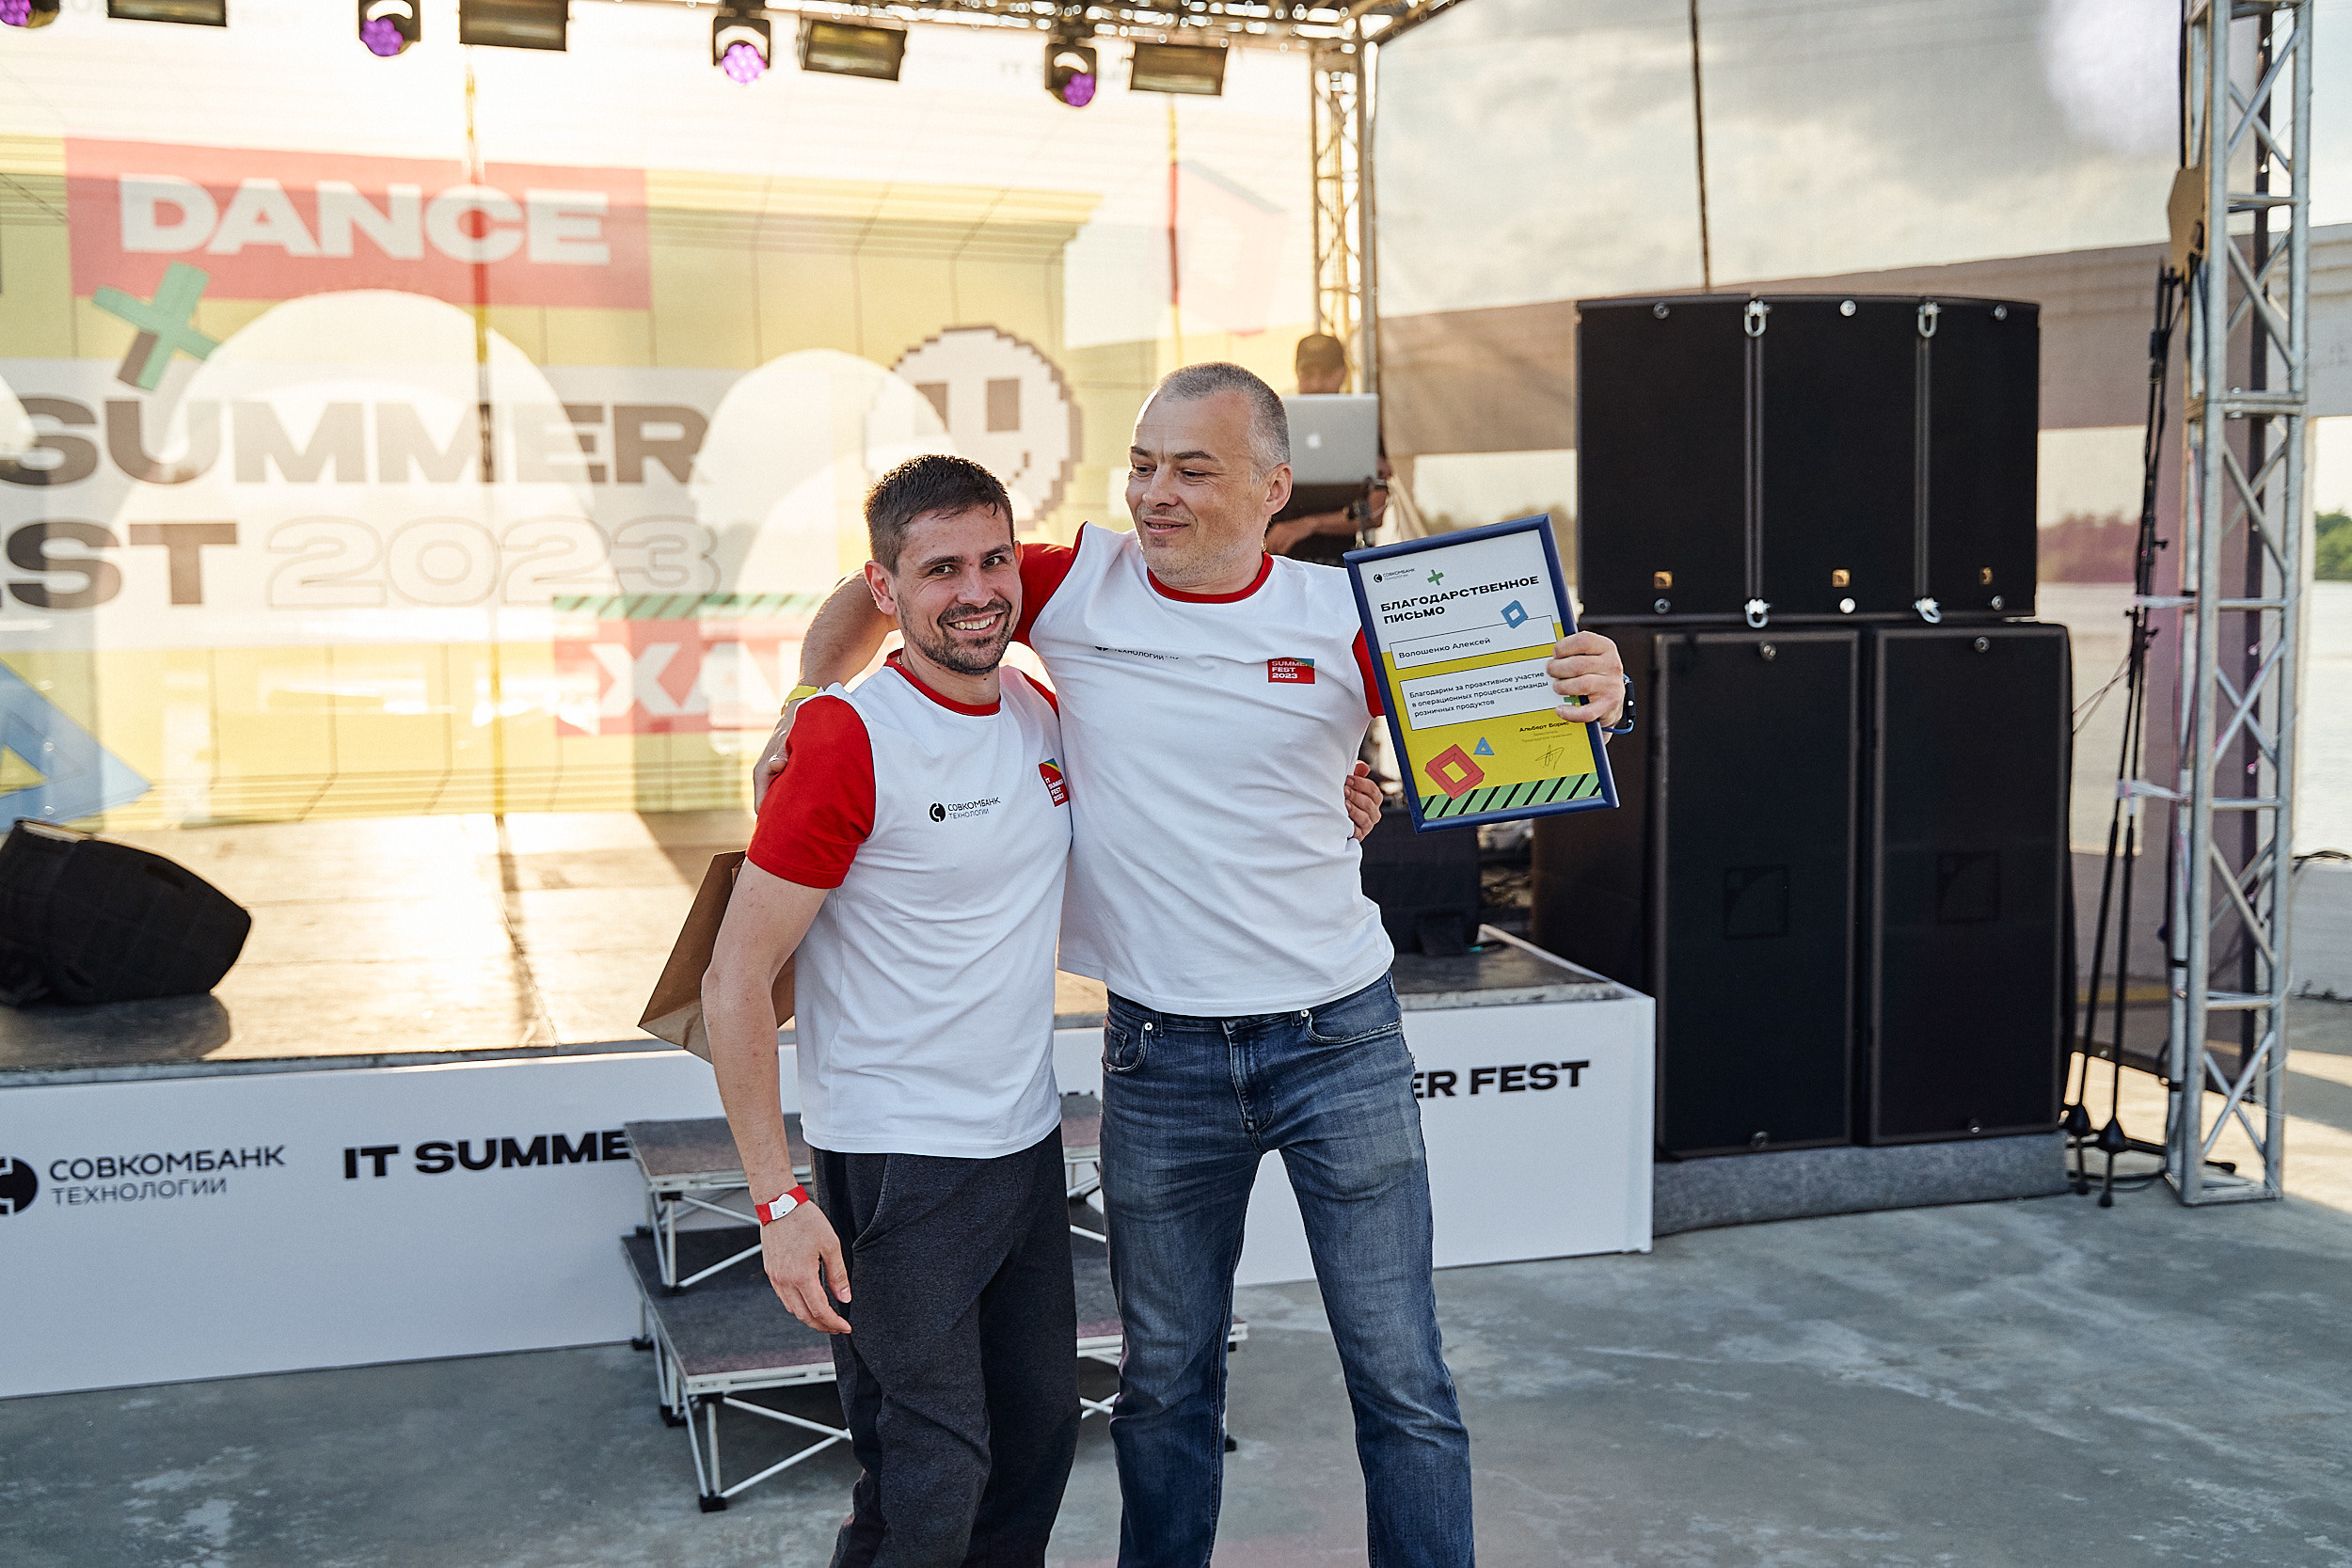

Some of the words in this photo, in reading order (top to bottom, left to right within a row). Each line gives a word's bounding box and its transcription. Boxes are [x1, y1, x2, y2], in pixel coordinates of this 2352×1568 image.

[119, 174, 611, 266] DANCE
[0, 397, 711, 486] SUMMER
[0, 520, 238, 610] ST
[266, 515, 722, 610] 2023
[1380, 576, 1539, 611] БЛАГОДАРСТВЕННОЕ
[1384, 607, 1445, 624] ПИСЬМО
[1114, 648, 1165, 660] ХНОЛОГИИ
[1399, 644, 1450, 658] Волошенко
[1453, 638, 1490, 649] Алексей
[1409, 687, 1454, 699] Благодарим
[1465, 676, 1513, 690] проактивное
[1514, 672, 1545, 683] участие
[1418, 693, 1472, 708] операционных
[1473, 687, 1513, 700] процессах
[1514, 681, 1549, 691] команды
[1414, 705, 1454, 718] розничных
[1456, 700, 1495, 712] продуктов
[947, 797, 1001, 812] СОВКОМБАНК
[949, 809, 990, 819] ТЕХНОЛОГИИ
[1413, 1069, 1457, 1099] ER
[1470, 1060, 1590, 1095] FEST
[50, 1145, 285, 1181] СОВКОМБАНК
[344, 1145, 400, 1180] IT
[415, 1130, 633, 1174] SUMME
[51, 1178, 228, 1205] ТЕХНОЛОГИИ
